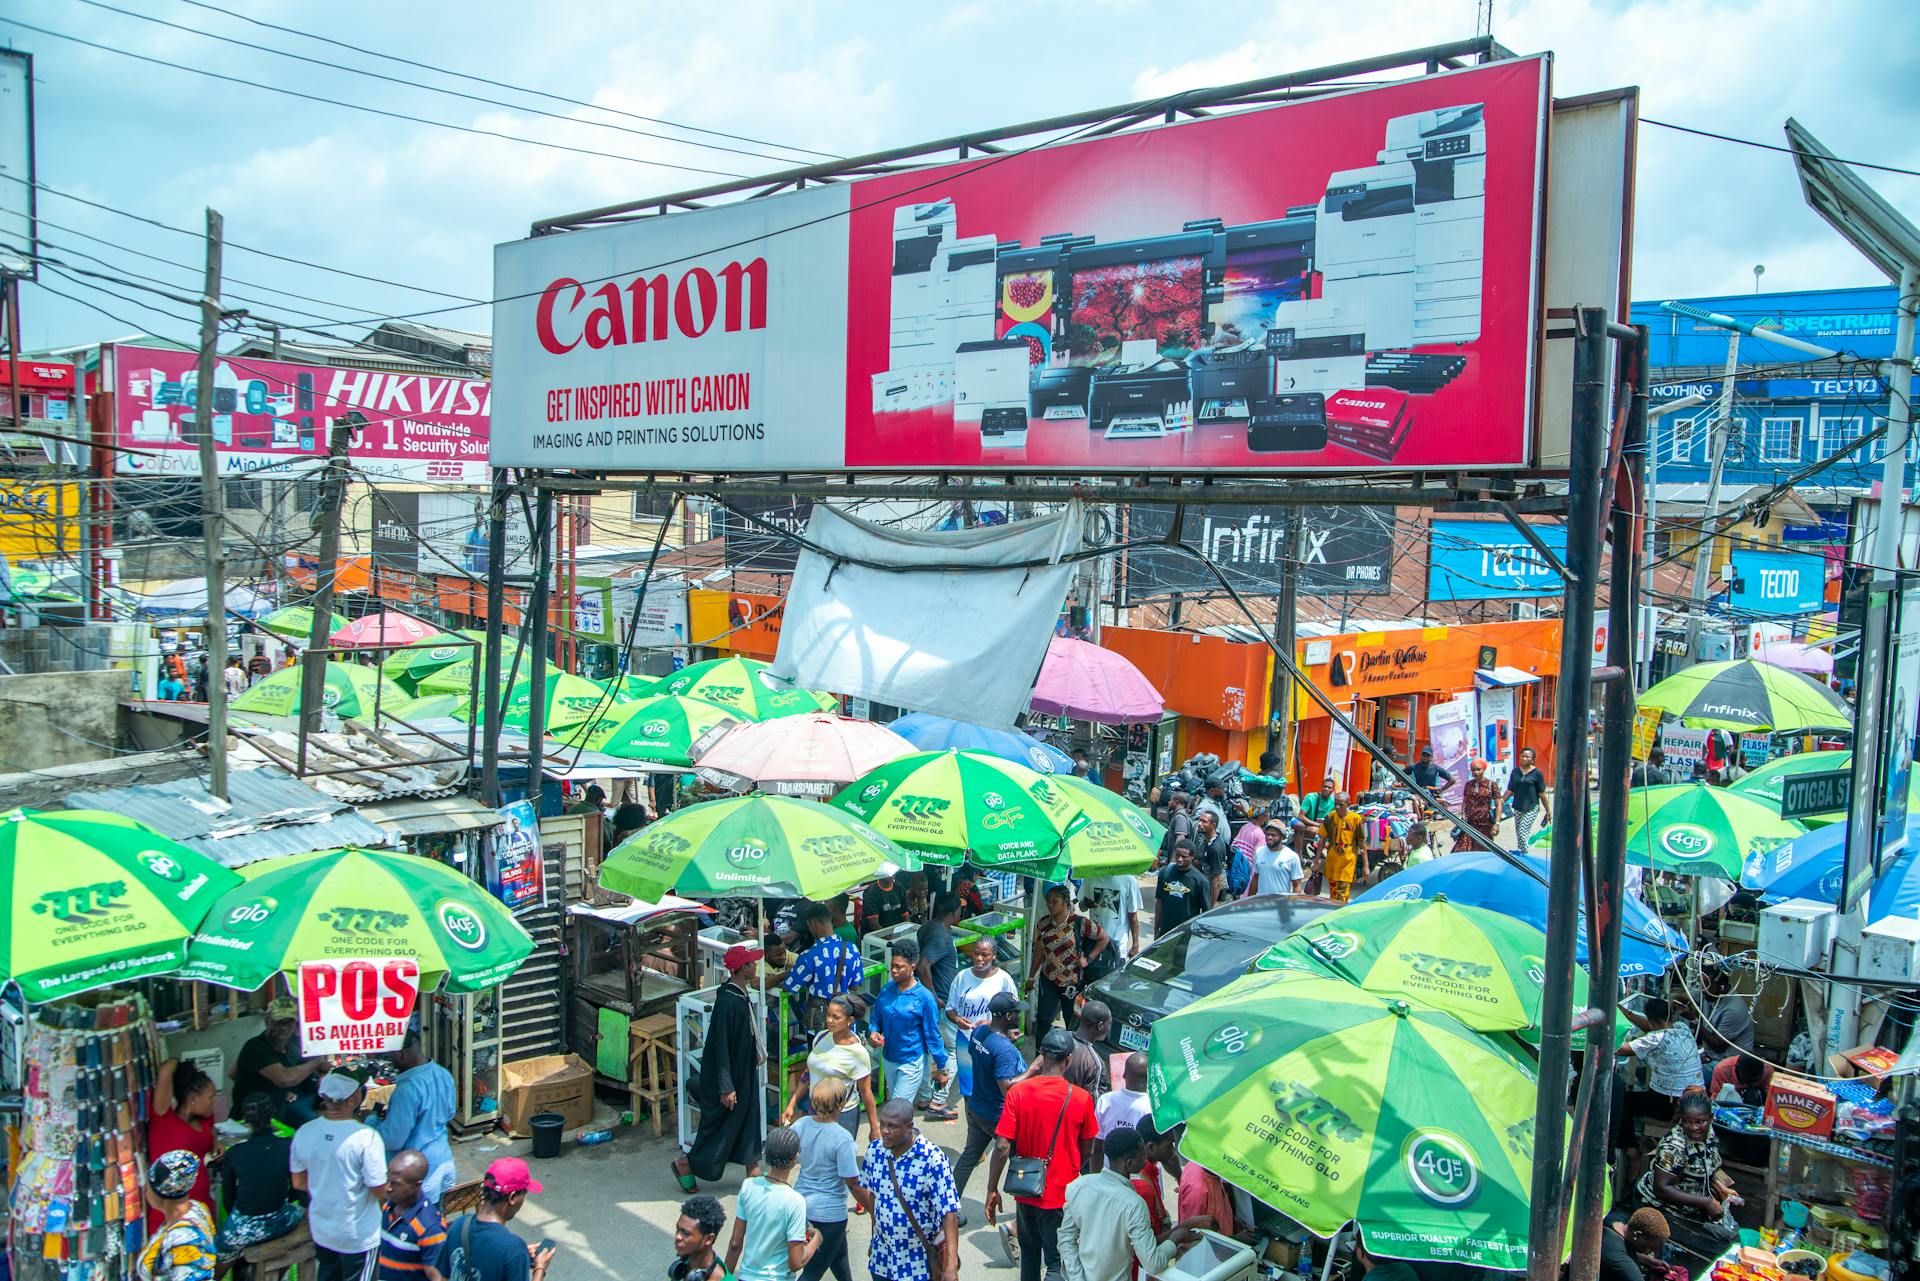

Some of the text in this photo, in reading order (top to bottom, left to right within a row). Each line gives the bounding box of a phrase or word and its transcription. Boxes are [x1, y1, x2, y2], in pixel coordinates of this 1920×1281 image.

[536, 257, 768, 354] Canon
[1783, 314, 1892, 332] SPECTRUM
[1855, 327, 1890, 336] LIMITED
[1652, 384, 1713, 397] NOTHING
[1810, 379, 1878, 394] TECNO
[547, 372, 750, 422] GET INSPIRED WITH CANON
[1335, 397, 1386, 409] Canon
[403, 419, 471, 438] Worldwide
[533, 423, 765, 449] IMAGING AND PRINTING SOLUTIONS
[403, 437, 458, 457] Security
[1346, 565, 1381, 581] DR PHONES
[1760, 569, 1800, 599] TECNO
[1665, 638, 1688, 657] PLAZA
[1702, 702, 1759, 720] Infinix
[643, 722, 666, 736] glo
[630, 739, 671, 748] Unlimited
[1664, 737, 1702, 749] REPAIR
[1742, 739, 1768, 751] FLASH
[776, 781, 836, 796] TRANSPARENT
[1787, 780, 1835, 812] OTIGBA
[985, 795, 1003, 809] glo
[887, 823, 929, 834] EVERYTHING
[908, 818, 927, 827] CODE
[730, 844, 765, 863] glo
[997, 849, 1039, 861] DATA PLANS
[998, 840, 1035, 851] VOICE AND
[920, 850, 951, 861] Network
[715, 871, 772, 884] Unlimited
[228, 902, 270, 925] glo
[54, 913, 135, 936] ONE CODE FOR
[51, 922, 147, 947] EVERYTHING GLO
[193, 933, 254, 951] Unlimited
[331, 936, 408, 946] ONE CODE FOR
[323, 946, 417, 957] EVERYTHING GLO
[38, 977, 61, 990] The
[61, 965, 109, 984] Largest
[126, 951, 176, 967] Network
[302, 959, 419, 1023] POS
[1402, 979, 1499, 1005] EVERYTHING GLO
[1409, 973, 1491, 994] ONE CODE FOR
[308, 1021, 408, 1041] IS AVAILABL
[1214, 1025, 1249, 1054] glo
[339, 1037, 385, 1051] HERE
[1179, 1035, 1203, 1083] Unlimited
[1776, 1093, 1823, 1115] MIMEE
[1260, 1114, 1341, 1165] ONE CODE FOR
[1245, 1121, 1341, 1182] EVERYTHING GLO
[1418, 1149, 1454, 1184] 4g
[1222, 1153, 1311, 1210] VOICE & DATA PLANS
[1371, 1231, 1418, 1242] SUPERIOR
[1419, 1233, 1459, 1246] QUALITY
[1466, 1237, 1504, 1251] FASTEST
[1430, 1246, 1483, 1261] BEST VALUE
